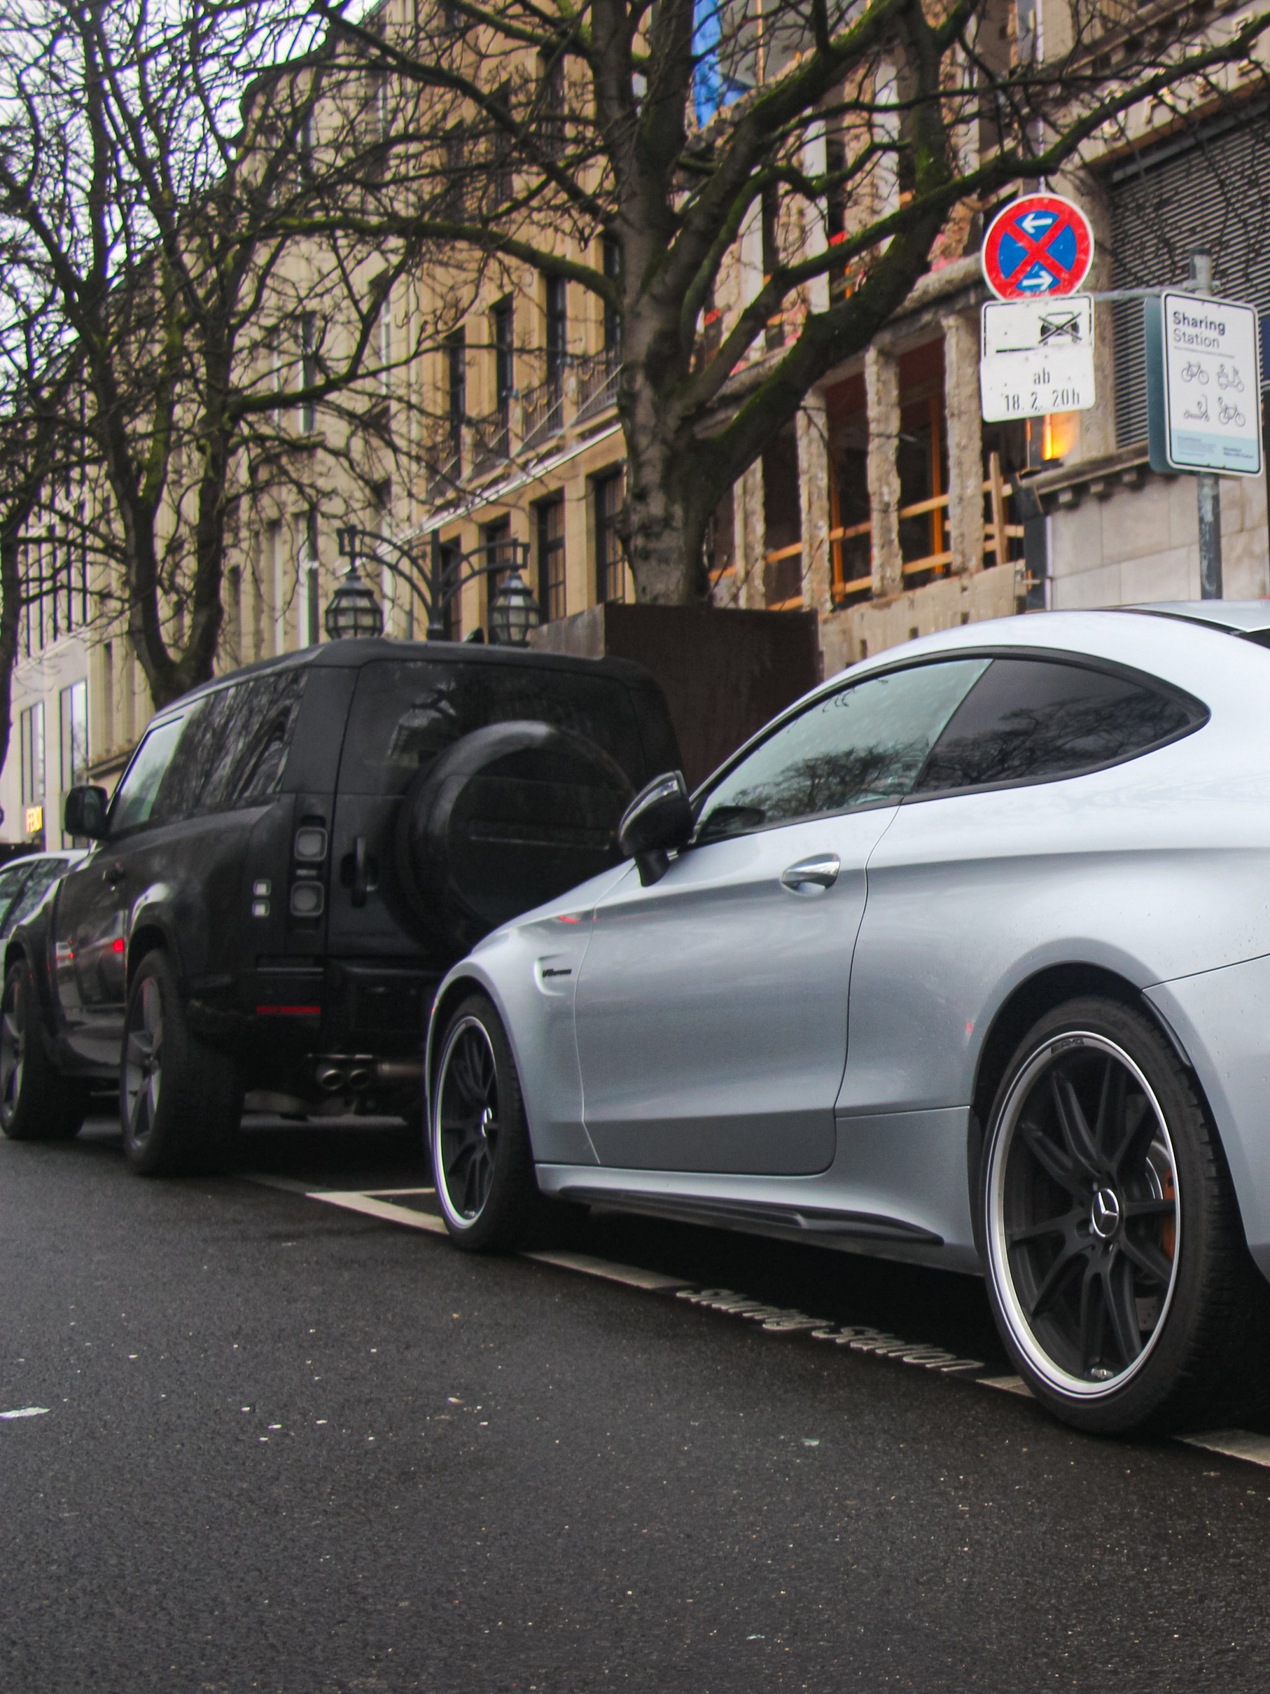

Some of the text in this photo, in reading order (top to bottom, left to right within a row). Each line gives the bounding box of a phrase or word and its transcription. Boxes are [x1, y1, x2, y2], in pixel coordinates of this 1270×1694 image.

[1173, 311, 1226, 336] Sharing
[1173, 327, 1220, 349] Station
[1033, 367, 1051, 385] ab
[1052, 387, 1080, 407] 20h
[811, 1326, 985, 1372] Station
